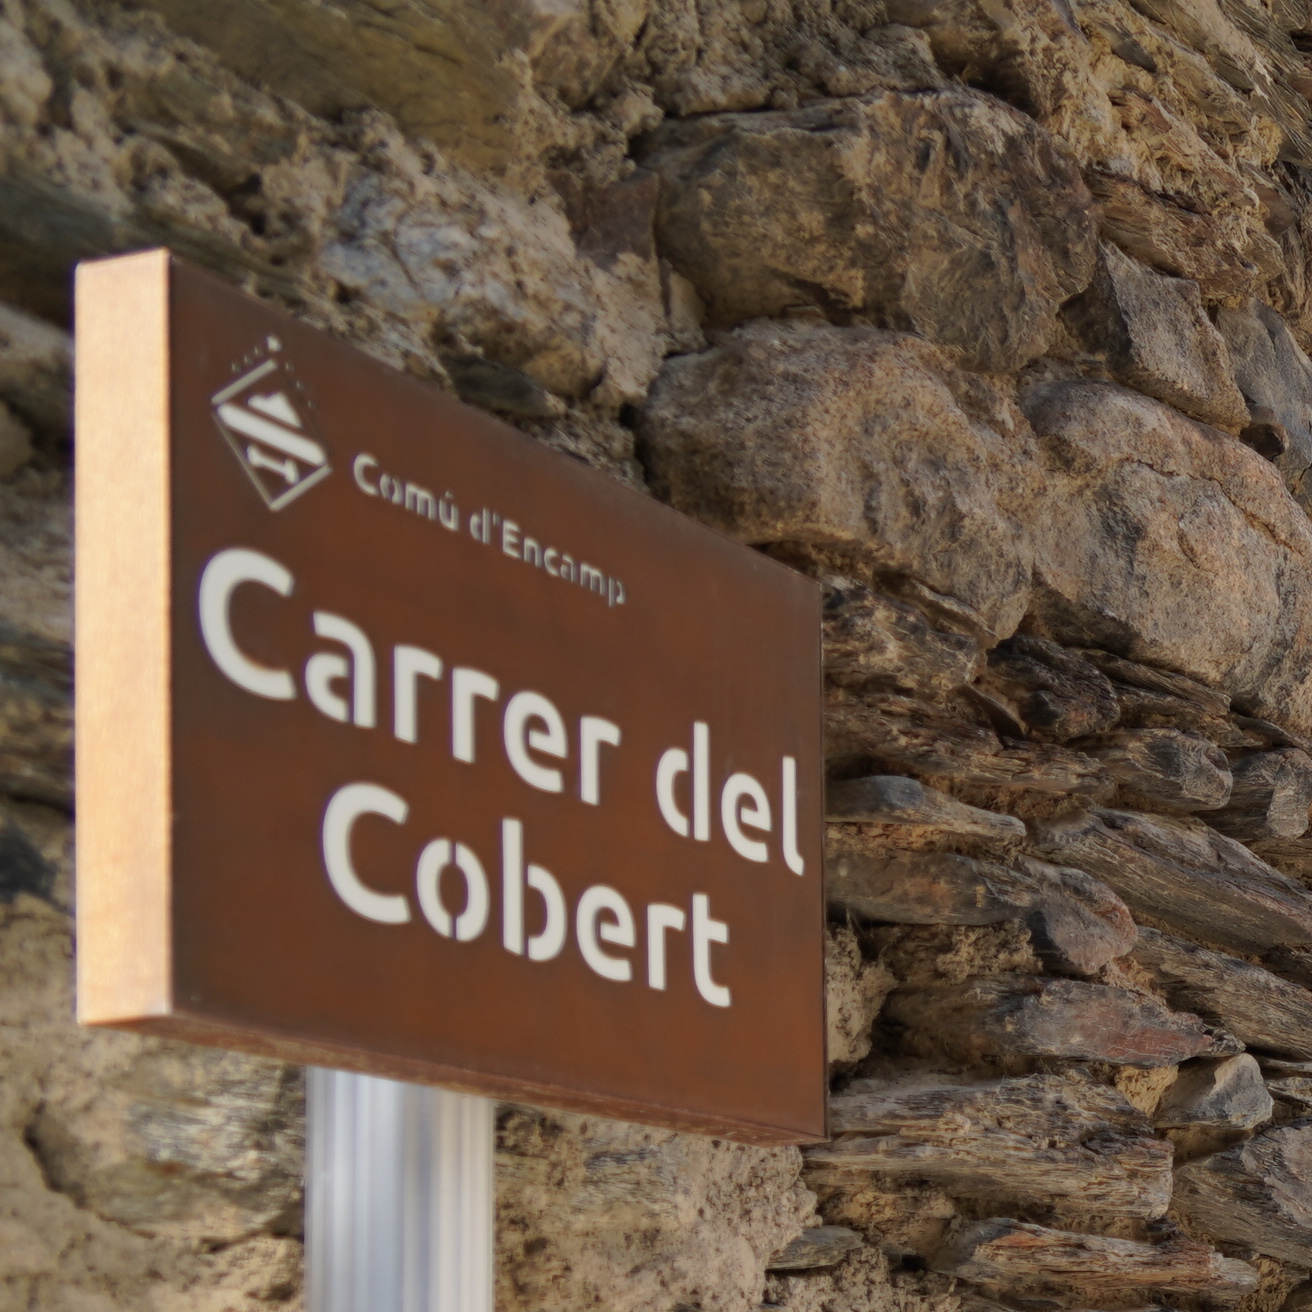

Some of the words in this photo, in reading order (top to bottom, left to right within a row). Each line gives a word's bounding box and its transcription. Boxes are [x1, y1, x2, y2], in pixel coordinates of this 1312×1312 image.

[469, 506, 626, 607] d'Encamp
[199, 547, 621, 806] Carrer
[655, 720, 804, 876] del
[322, 782, 732, 1008] Cobert
